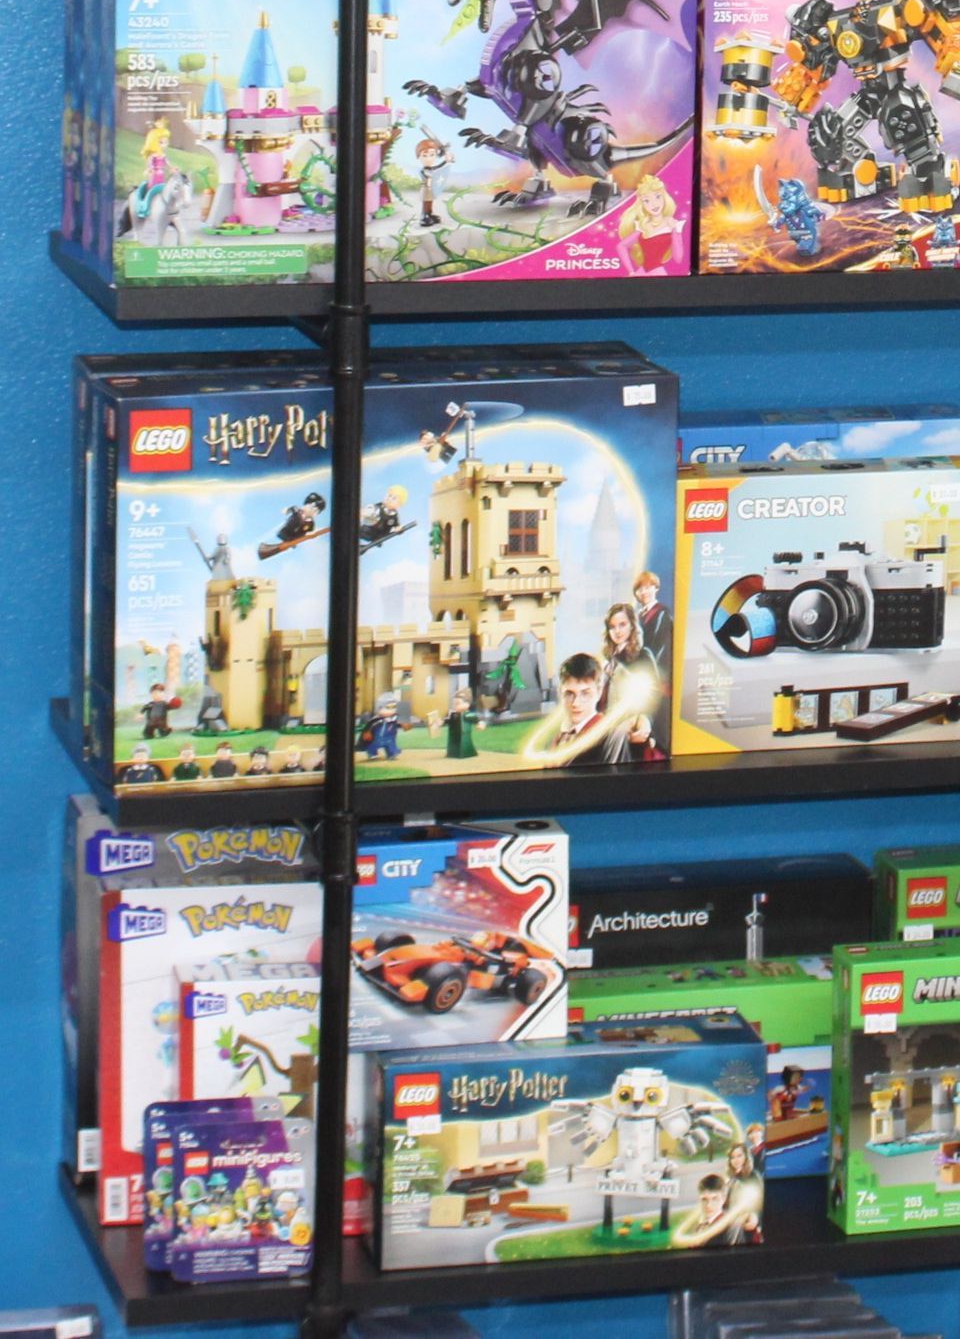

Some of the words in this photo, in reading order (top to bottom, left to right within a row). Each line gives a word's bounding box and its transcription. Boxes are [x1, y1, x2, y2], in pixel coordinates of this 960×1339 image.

[128, 17, 169, 28] 43240
[713, 11, 731, 22] 235
[128, 54, 155, 71] 583
[127, 70, 179, 90] pcs/pzs
[545, 258, 620, 271] PRINCESS
[133, 427, 191, 453] LEGO
[203, 413, 284, 466] Harry
[690, 445, 747, 463] CITY
[129, 500, 160, 522] 9+
[686, 500, 726, 519] LEGO
[737, 495, 847, 521] CREATOR
[701, 542, 725, 556] 8+
[128, 574, 155, 592] 651
[105, 842, 151, 867] MEGA
[382, 859, 422, 878] CITY
[910, 889, 944, 906] LEGO
[124, 913, 165, 933] MEGA
[587, 908, 710, 939] Architecture
[863, 984, 901, 1004] LEGO
[196, 998, 225, 1012] MEGA
[396, 1084, 440, 1105] LEGO
[448, 1075, 507, 1113] Harry
[508, 1068, 568, 1101] Potter
[393, 1135, 416, 1151] 7+
[212, 1150, 302, 1166] minifigures
[856, 1191, 877, 1206] 7+
